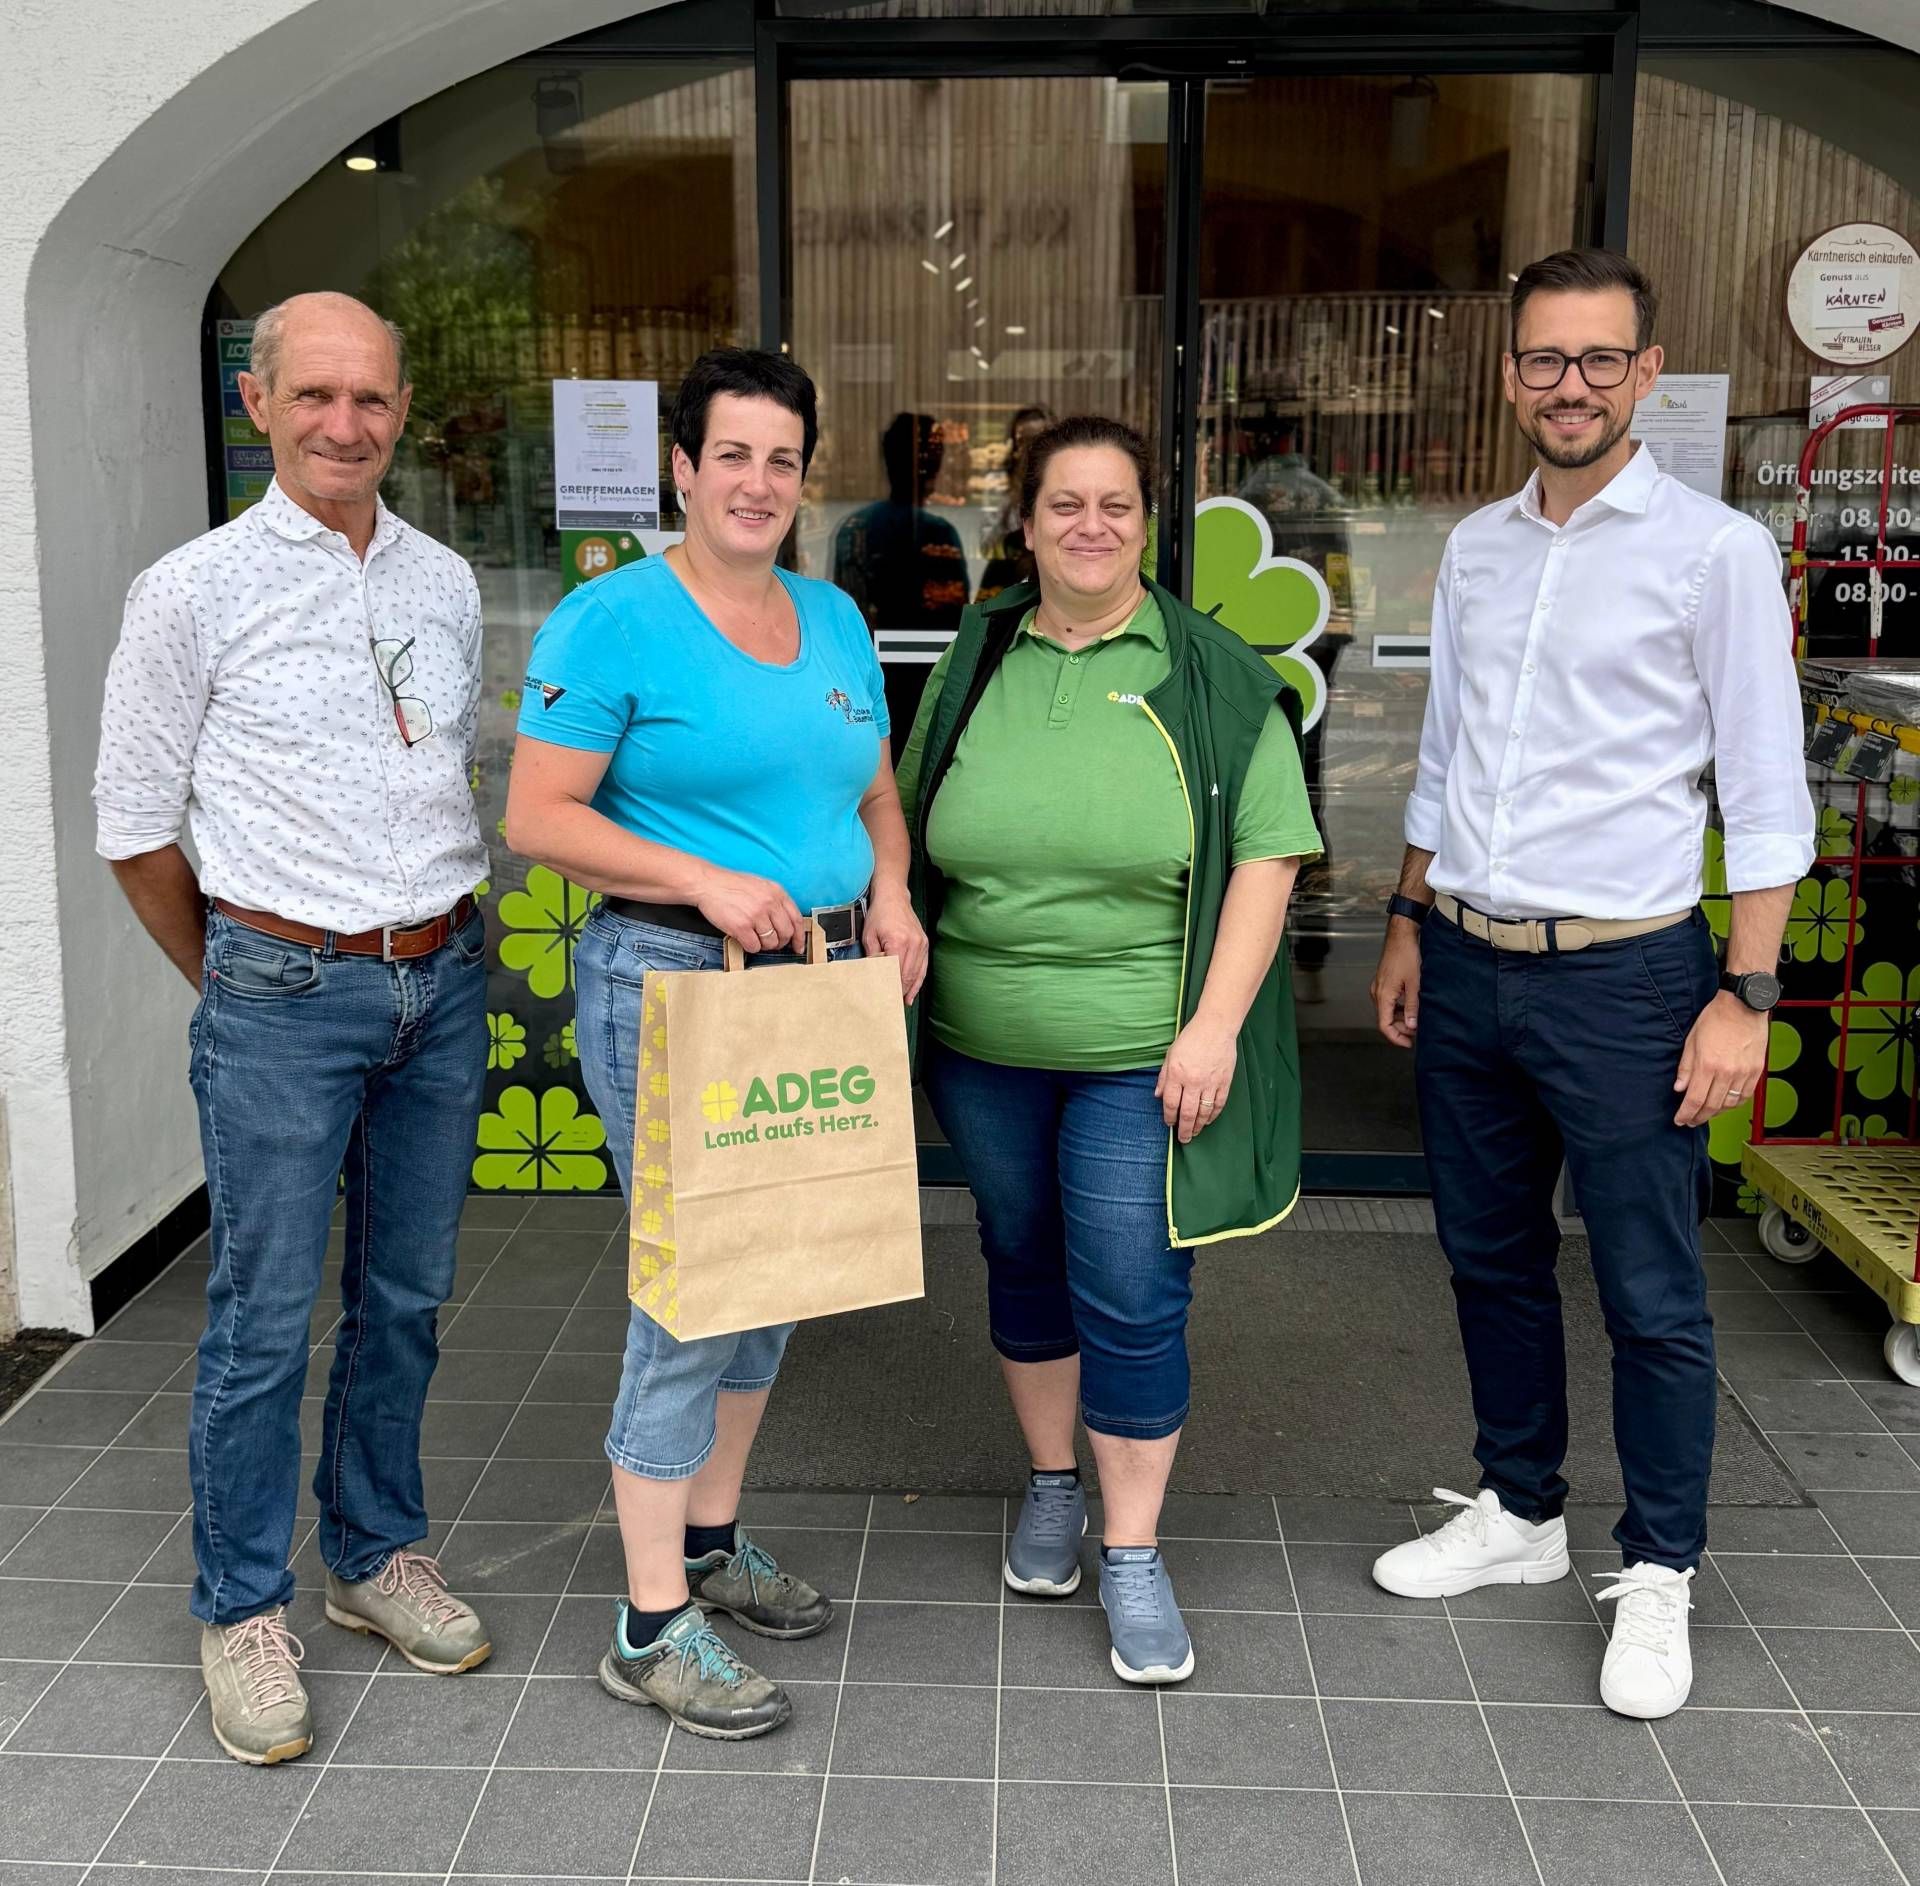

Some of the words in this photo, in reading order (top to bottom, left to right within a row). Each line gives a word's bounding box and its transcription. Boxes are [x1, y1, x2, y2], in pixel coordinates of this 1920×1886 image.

[1868, 251, 1913, 265] einkaufen
[1820, 273, 1853, 281] Genuss
[1757, 460, 1920, 491] Öffungszite
[560, 485, 656, 495] GREIFFENHAGEN
[583, 545, 608, 571] jö
[742, 1065, 876, 1118] ADEG
[704, 1123, 760, 1149] Land
[764, 1117, 814, 1140] aufs
[819, 1113, 879, 1133] Herz.
